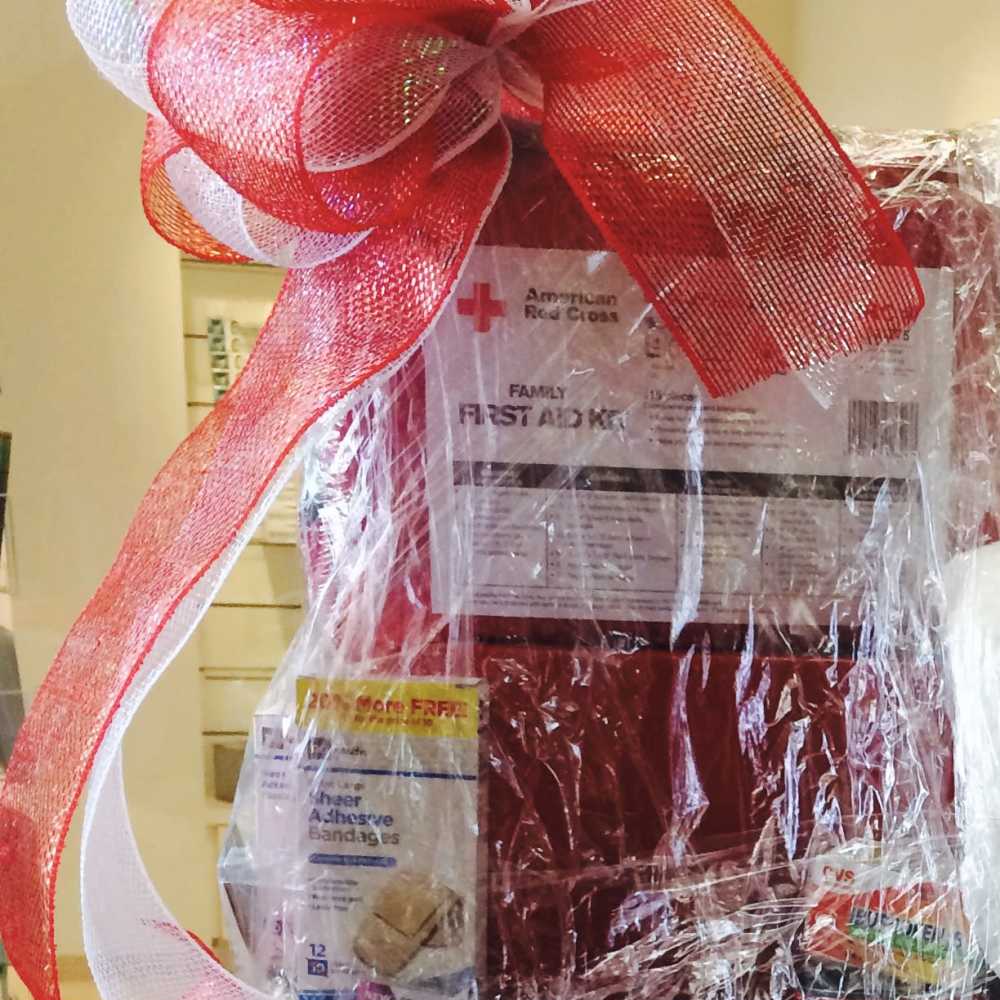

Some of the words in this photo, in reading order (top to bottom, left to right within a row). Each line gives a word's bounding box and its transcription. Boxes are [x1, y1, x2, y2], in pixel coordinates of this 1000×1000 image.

[525, 287, 618, 307] American
[524, 305, 560, 321] Red
[566, 307, 620, 323] Cross
[509, 383, 567, 400] FAMILY
[458, 402, 532, 428] FIRST
[538, 407, 584, 429] AID
[355, 695, 408, 713] More
[411, 698, 469, 718] FREE
[308, 808, 394, 827] Adhesive
[308, 826, 400, 846] Bandages
[309, 943, 326, 957] 12
